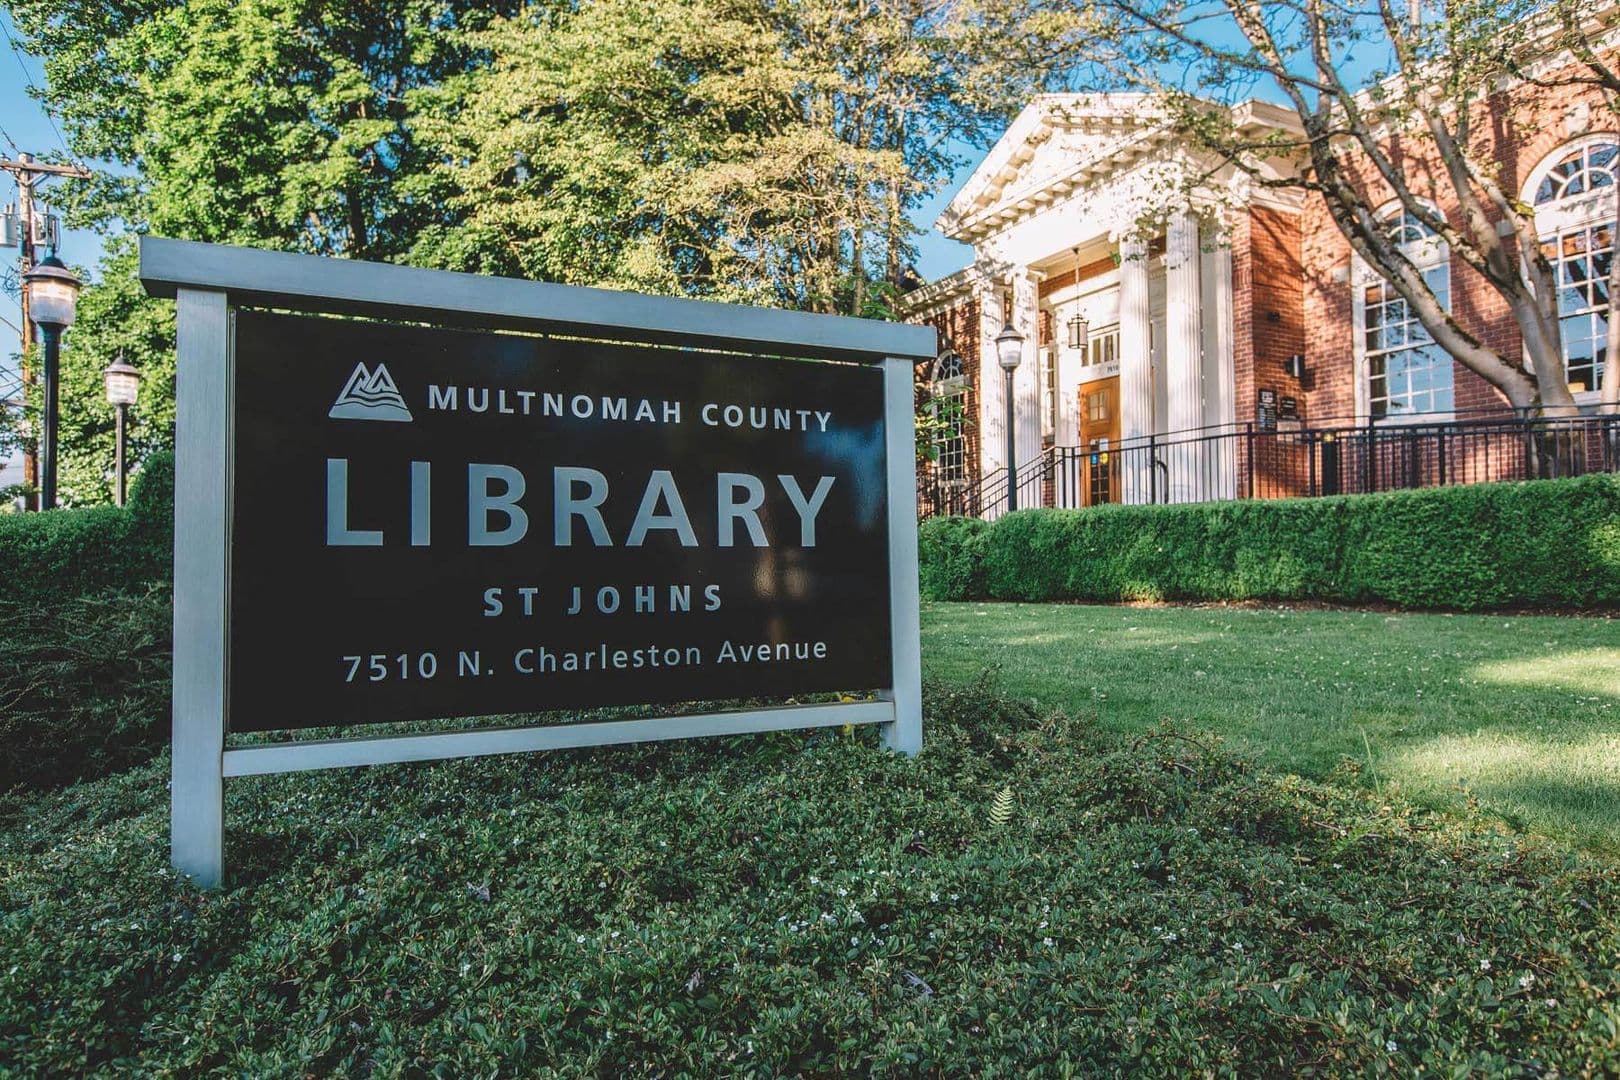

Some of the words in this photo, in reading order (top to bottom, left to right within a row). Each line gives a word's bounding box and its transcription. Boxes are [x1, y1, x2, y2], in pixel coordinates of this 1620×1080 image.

[428, 385, 682, 424] MULTNOMAH
[701, 404, 832, 432] COUNTY
[326, 458, 836, 547] LIBRARY
[484, 587, 540, 616] ST
[567, 584, 722, 615] JOHNS
[343, 653, 437, 682] 7510
[459, 651, 494, 677] N.
[514, 644, 702, 674] Charleston
[717, 641, 828, 664] Avenue
